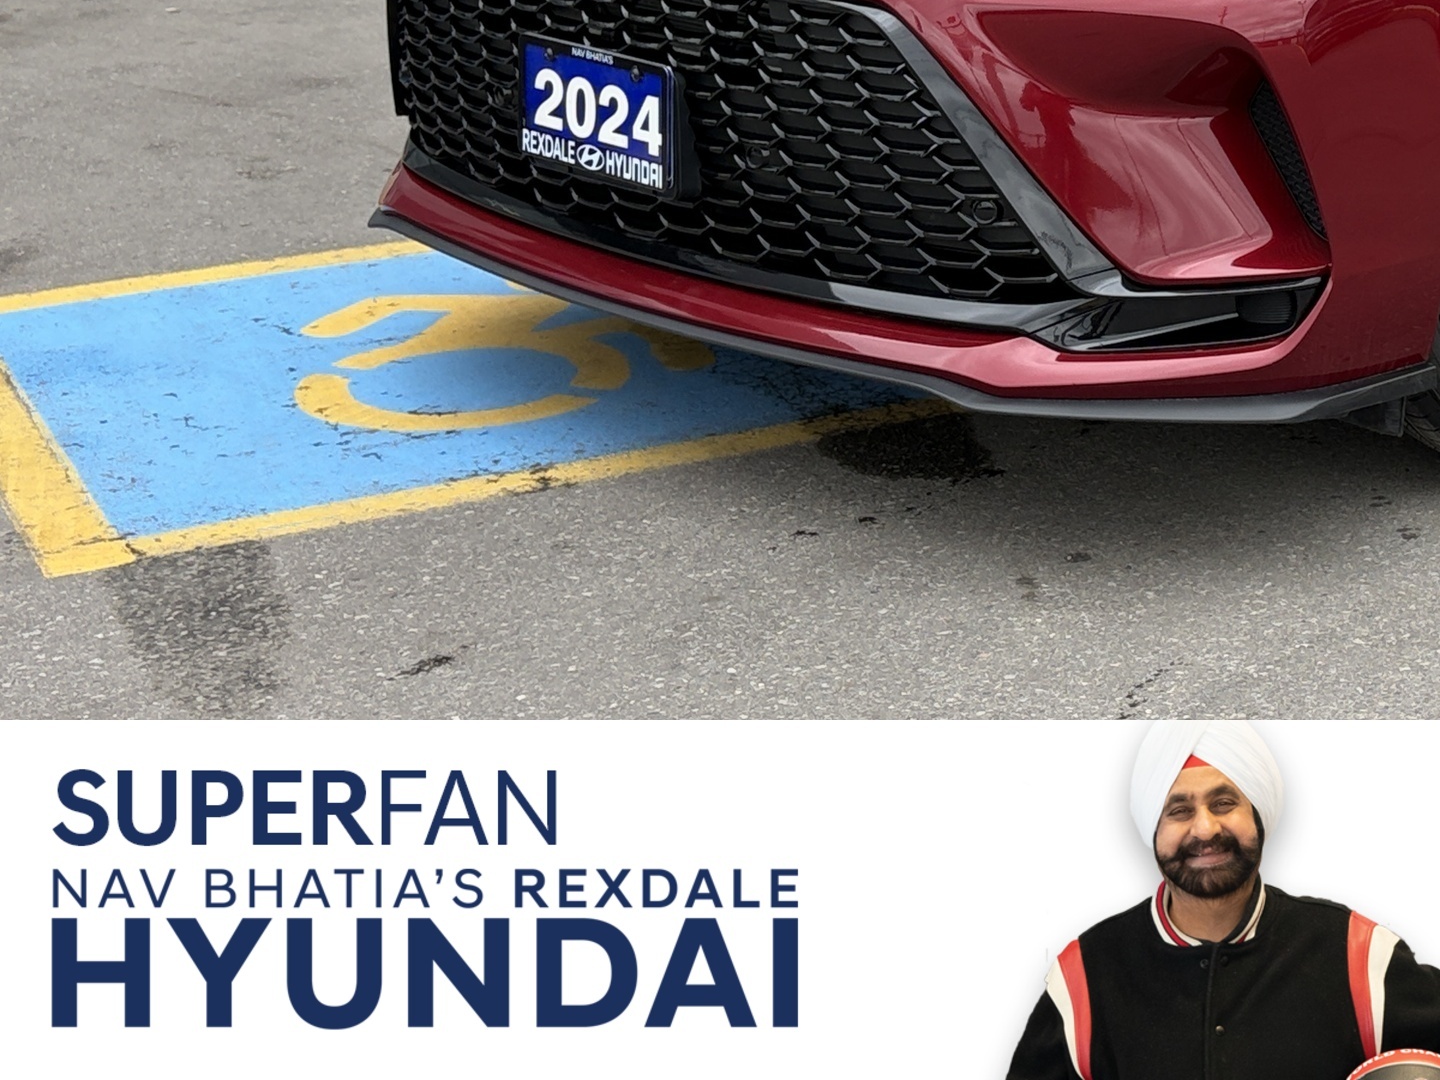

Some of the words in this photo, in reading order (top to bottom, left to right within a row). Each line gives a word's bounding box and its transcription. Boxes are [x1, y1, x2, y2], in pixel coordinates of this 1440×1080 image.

[571, 46, 586, 58] NAV
[533, 67, 663, 157] 2024
[521, 128, 576, 165] REXDALE
[605, 150, 663, 189] HYUNDAI
